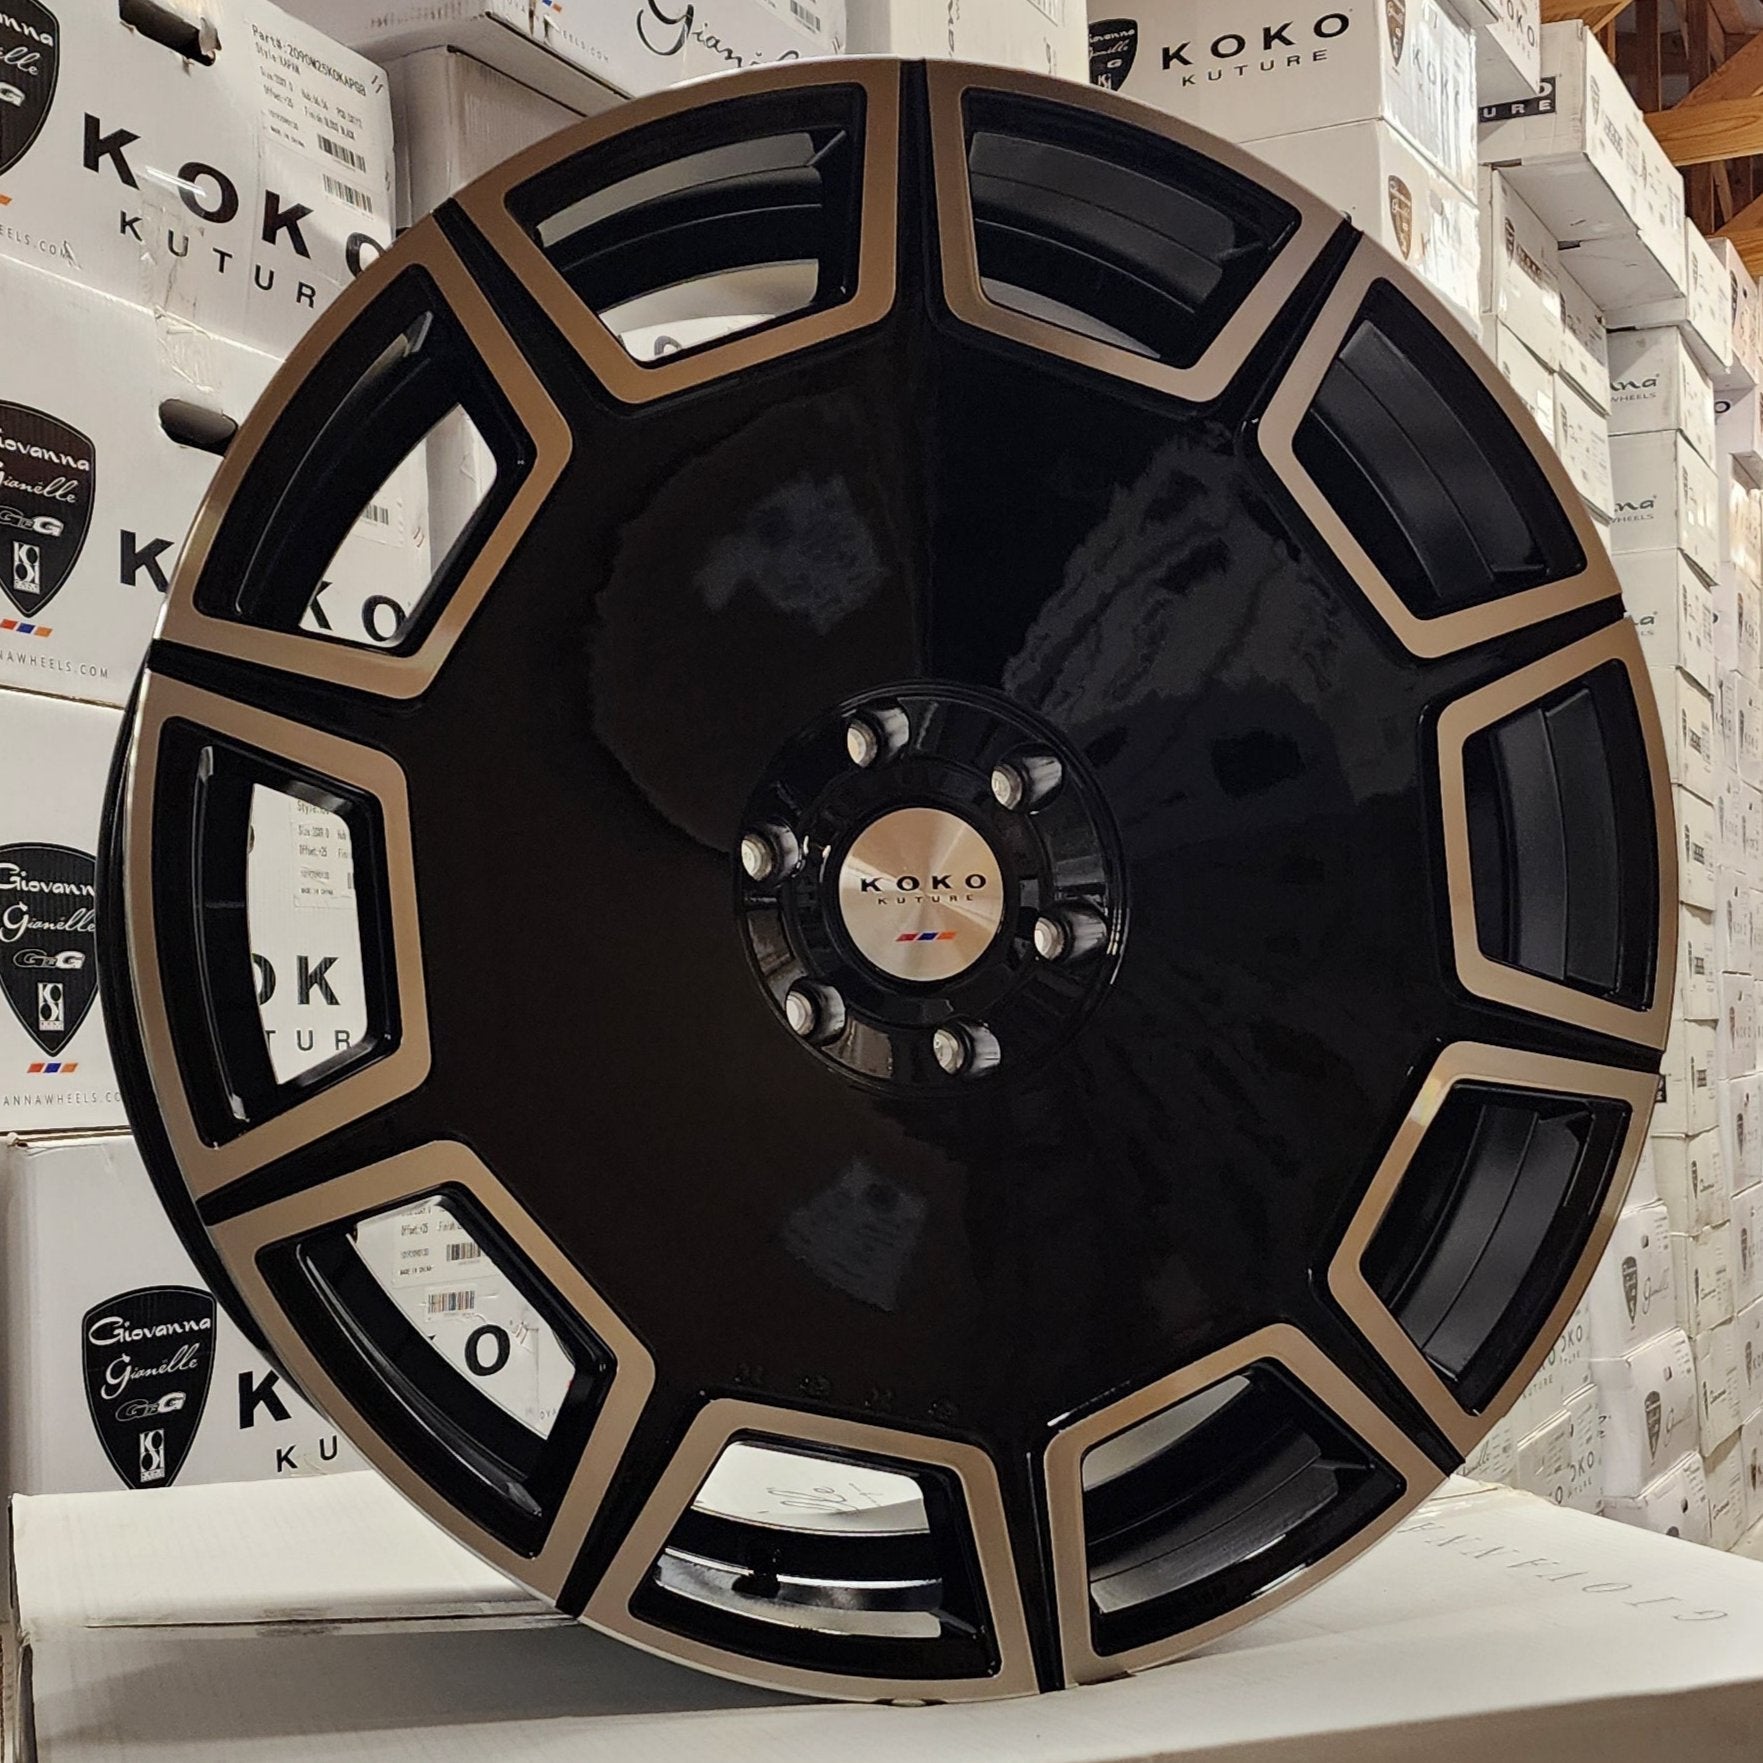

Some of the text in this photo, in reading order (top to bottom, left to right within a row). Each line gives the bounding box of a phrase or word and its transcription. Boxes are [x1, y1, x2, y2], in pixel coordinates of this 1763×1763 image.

[1162, 13, 1349, 70] KOKO
[1181, 49, 1328, 87] KUTURE
[1483, 100, 1552, 118] URE
[83, 112, 386, 278] KOKO
[120, 210, 316, 308] KUTUR
[0, 428, 90, 472] iovanna
[0, 863, 97, 897] Giovann
[860, 873, 987, 892] KOKO
[3, 1091, 121, 1107] ANNAWHEELS.CO
[88, 1316, 212, 1346] Giovanna
